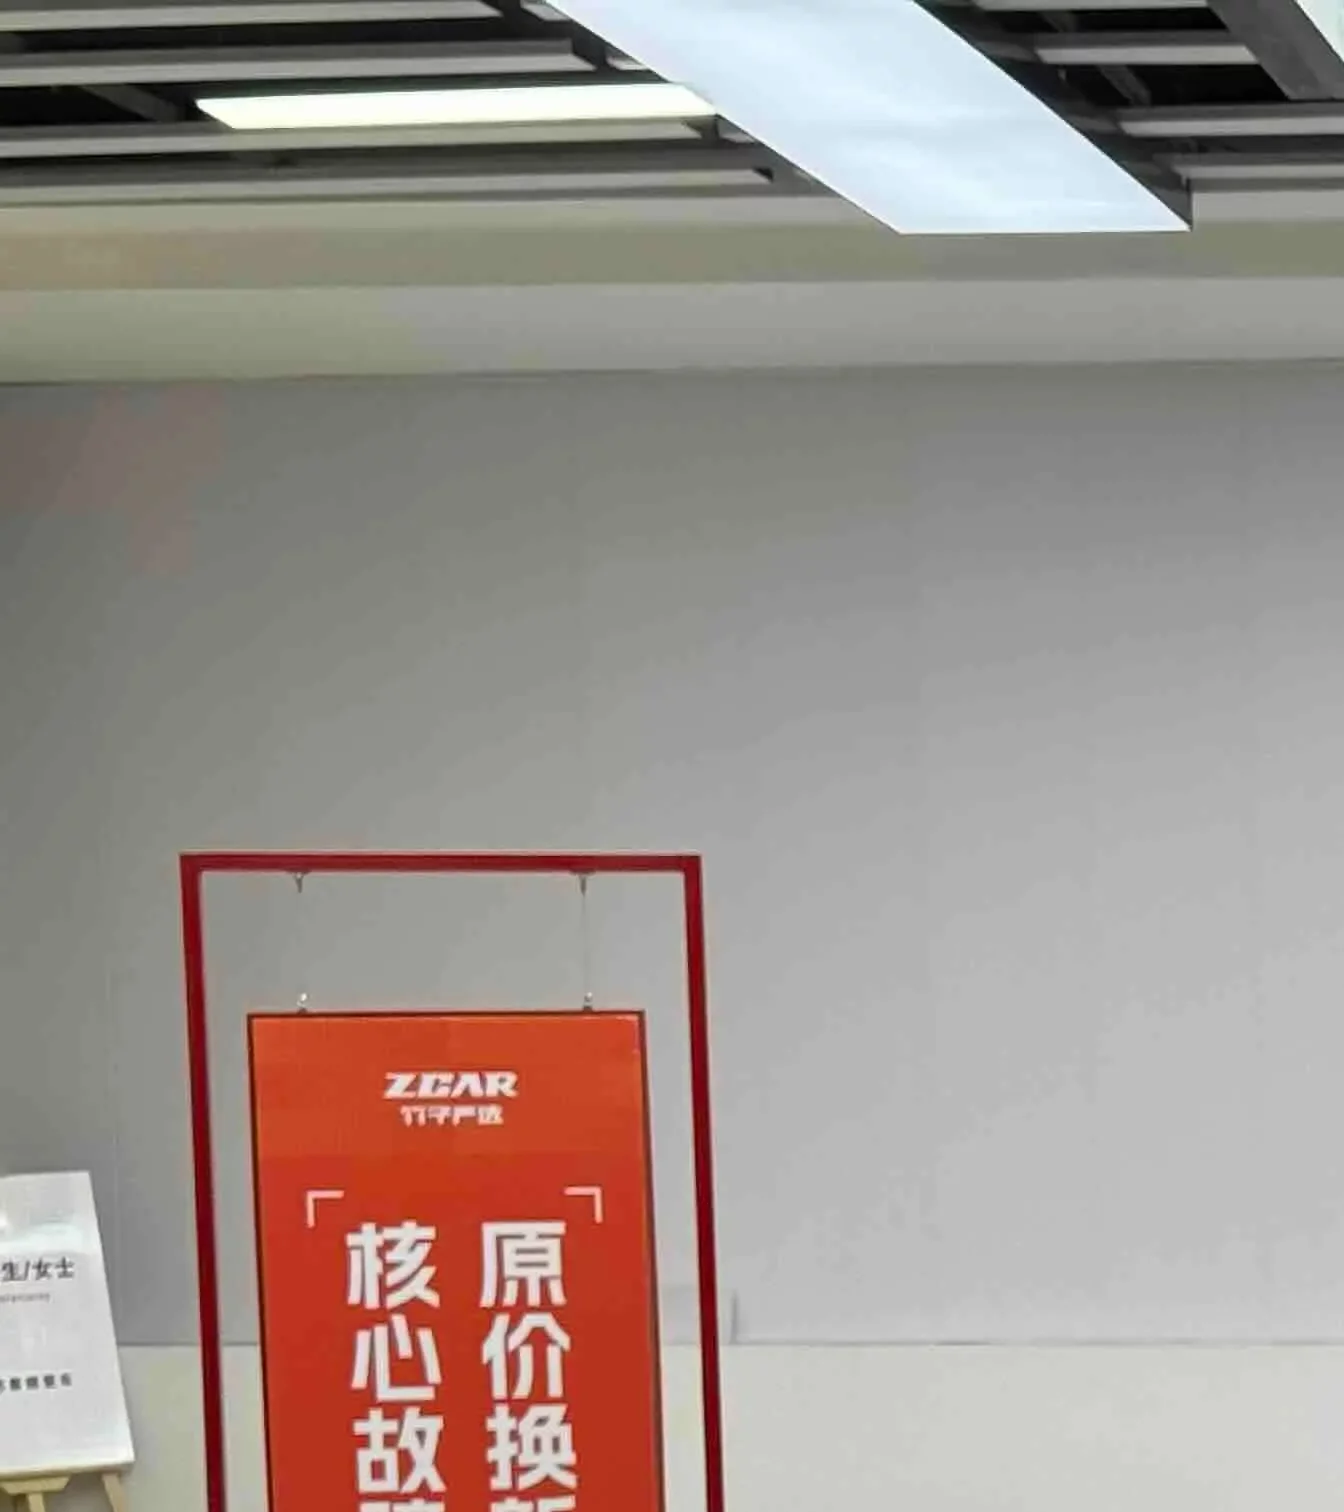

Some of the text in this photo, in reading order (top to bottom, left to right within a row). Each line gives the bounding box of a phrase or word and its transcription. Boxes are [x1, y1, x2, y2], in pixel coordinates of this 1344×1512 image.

[383, 1071, 518, 1099] ZCAR
[400, 1103, 504, 1126] 竹子严选
